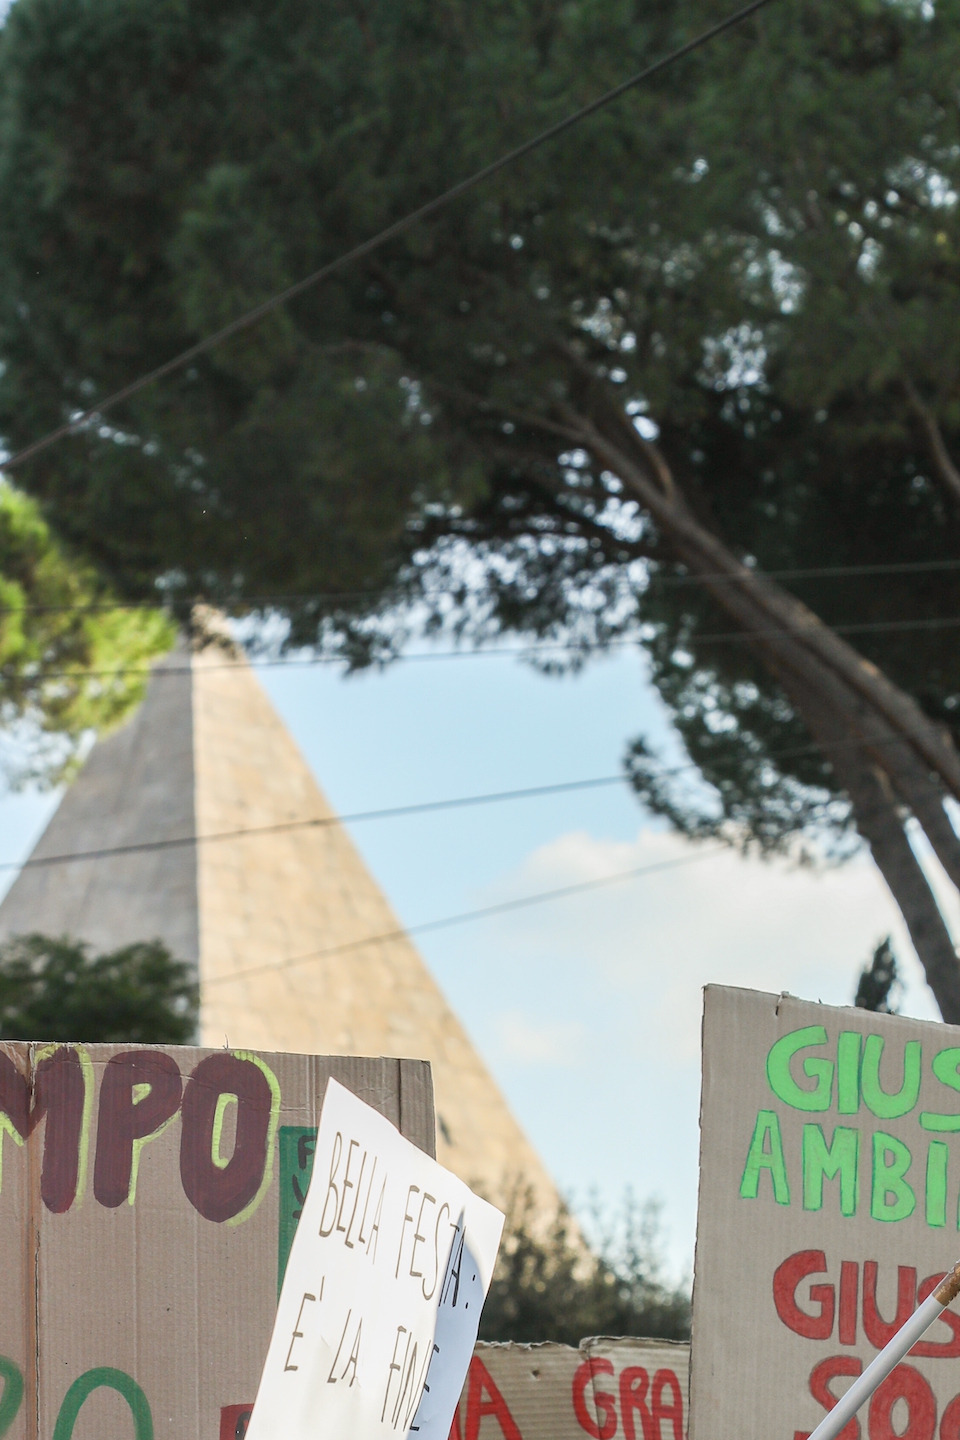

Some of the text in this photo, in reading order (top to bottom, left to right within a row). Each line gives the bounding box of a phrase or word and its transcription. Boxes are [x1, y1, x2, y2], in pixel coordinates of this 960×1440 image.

[318, 1130, 388, 1266] BELLA
[740, 1109, 960, 1232] AMBI
[283, 1275, 440, 1433] E' LA FINE
